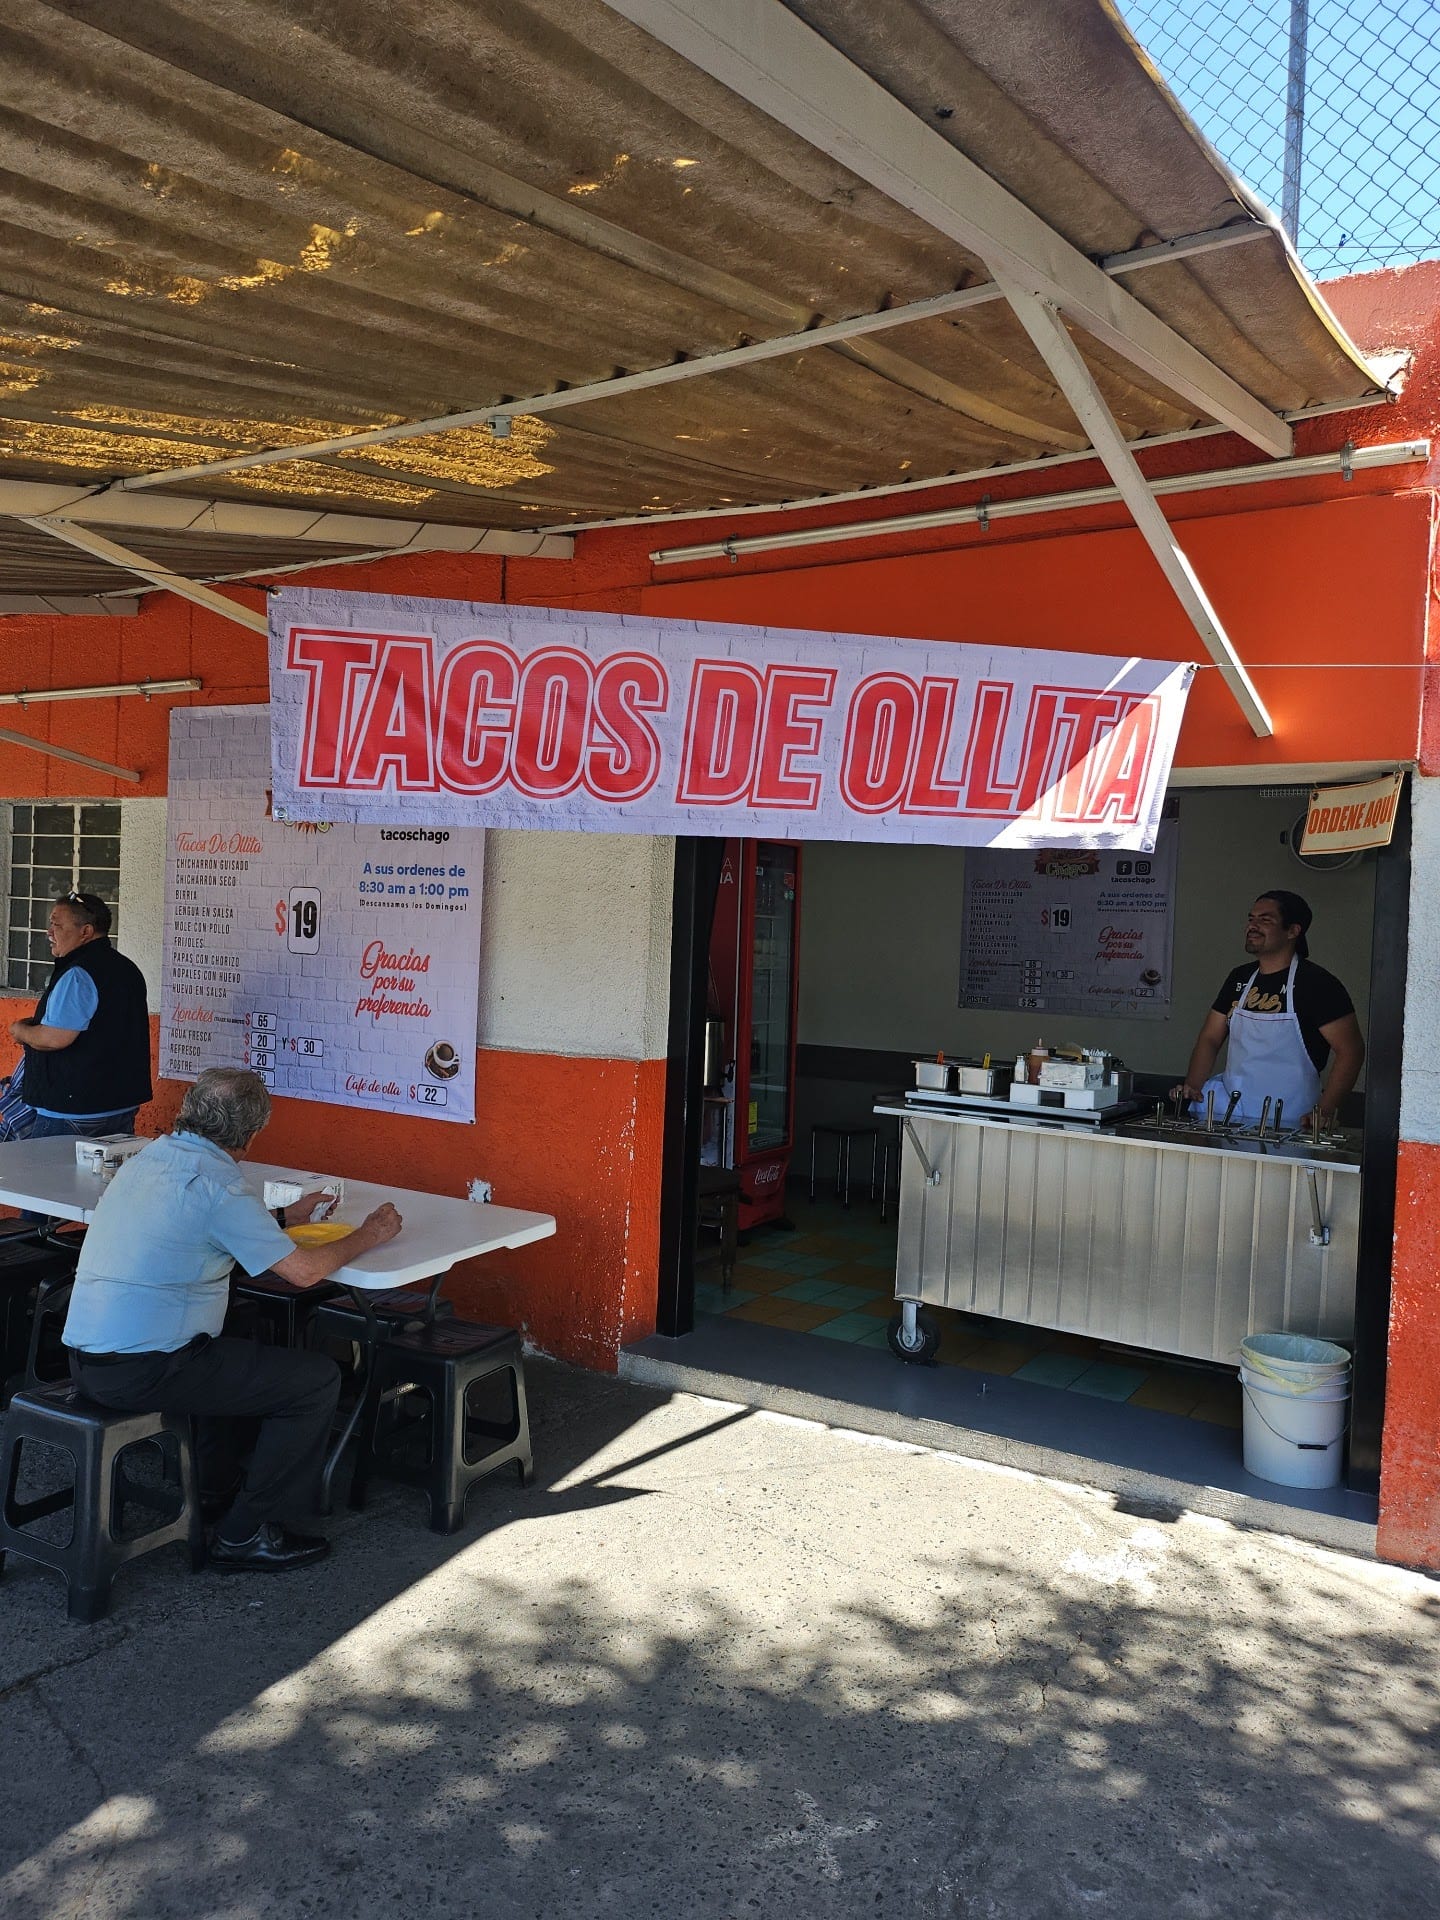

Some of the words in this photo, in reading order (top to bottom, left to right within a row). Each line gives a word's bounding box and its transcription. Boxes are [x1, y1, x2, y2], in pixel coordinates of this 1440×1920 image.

[287, 627, 669, 804] TACOS
[676, 658, 837, 810] DE
[840, 671, 1162, 824] OLLITA
[1308, 802, 1367, 835] ORDENE
[176, 832, 207, 852] Tacos
[208, 833, 228, 854] De
[228, 832, 263, 854] Ollita
[380, 828, 450, 844] tacoschago
[220, 860, 249, 871] GUISADO
[363, 862, 372, 874] A
[375, 864, 394, 875] sus
[397, 864, 445, 876] ordenes
[448, 864, 466, 877] de
[219, 876, 236, 887] SECO
[359, 881, 384, 893] 8:30
[387, 885, 405, 894] am
[408, 885, 416, 894] a
[419, 883, 445, 896] 1:00
[448, 886, 469, 899] pm
[175, 889, 197, 900] BIRRIA
[175, 905, 199, 917] LENGUA
[202, 906, 210, 917] EN
[212, 907, 234, 919] SALSA
[275, 900, 287, 936] $
[292, 901, 317, 938] 19
[1041, 909, 1049, 926] $
[1052, 909, 1070, 927] 19
[174, 921, 192, 932] MOLE
[194, 922, 207, 933] CON
[209, 923, 230, 935] POLLO
[1098, 925, 1144, 944] Gracias
[174, 936, 204, 948] FRIJOLES
[173, 952, 193, 963] PAPAS
[195, 953, 209, 965] CON
[211, 955, 240, 967] CHORIZO
[360, 940, 431, 979] Gracias
[172, 967, 201, 980] NOPALES
[203, 970, 217, 981] CON
[219, 971, 241, 983] HUEVO
[172, 983, 193, 995] HUEVO
[195, 985, 204, 996] EN
[206, 986, 227, 998] SALSA
[372, 975, 399, 995] por
[399, 978, 416, 992] su
[171, 1002, 214, 1023] Lonches
[245, 1013, 251, 1026] $
[257, 1014, 268, 1027] 65
[355, 993, 431, 1020] preferencia
[170, 1030, 187, 1040] AGUA
[188, 1031, 212, 1042] FRESCA
[244, 1032, 250, 1046] $
[257, 1035, 268, 1047] 20
[281, 1037, 287, 1049] Y
[290, 1038, 296, 1051] $
[303, 1040, 315, 1053] 30
[170, 1043, 201, 1057] REFRESCO
[244, 1051, 249, 1064] $
[256, 1053, 267, 1066] 20
[169, 1059, 192, 1072] POSTRE
[345, 1074, 368, 1097] Café
[368, 1079, 380, 1092] de
[381, 1082, 401, 1096] olla
[409, 1085, 416, 1100] $
[424, 1088, 437, 1102] 22
